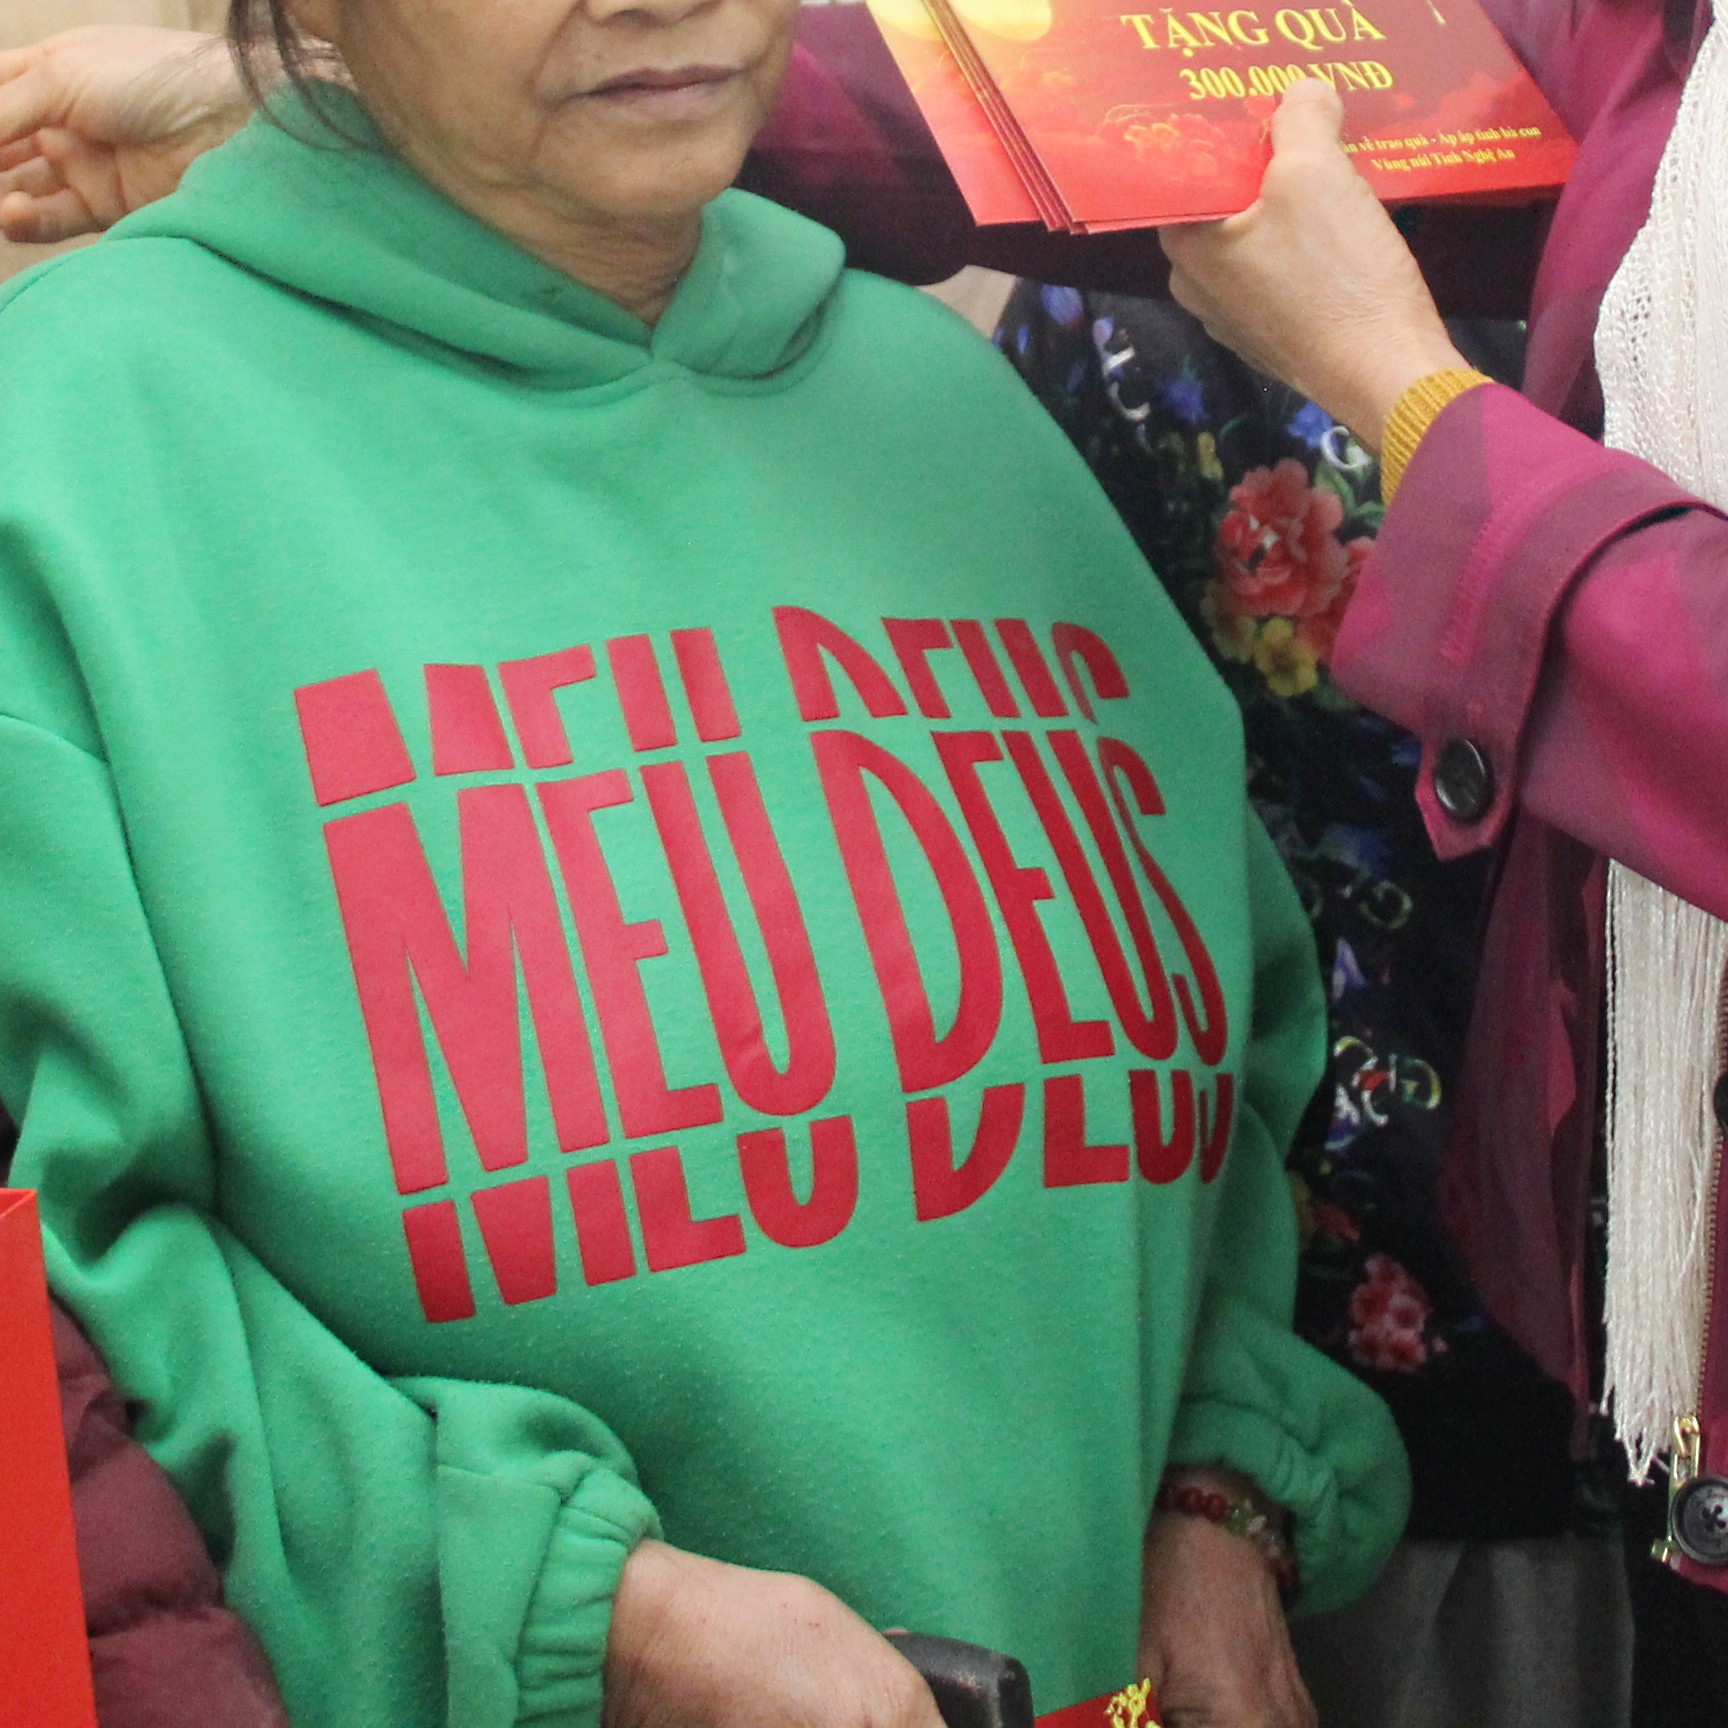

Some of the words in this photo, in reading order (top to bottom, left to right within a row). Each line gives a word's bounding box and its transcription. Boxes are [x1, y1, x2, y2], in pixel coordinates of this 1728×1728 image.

[1120, 7, 1270, 58] TẶNG
[323, 750, 838, 1195] MEU
[810, 728, 1227, 1093] DEUS
